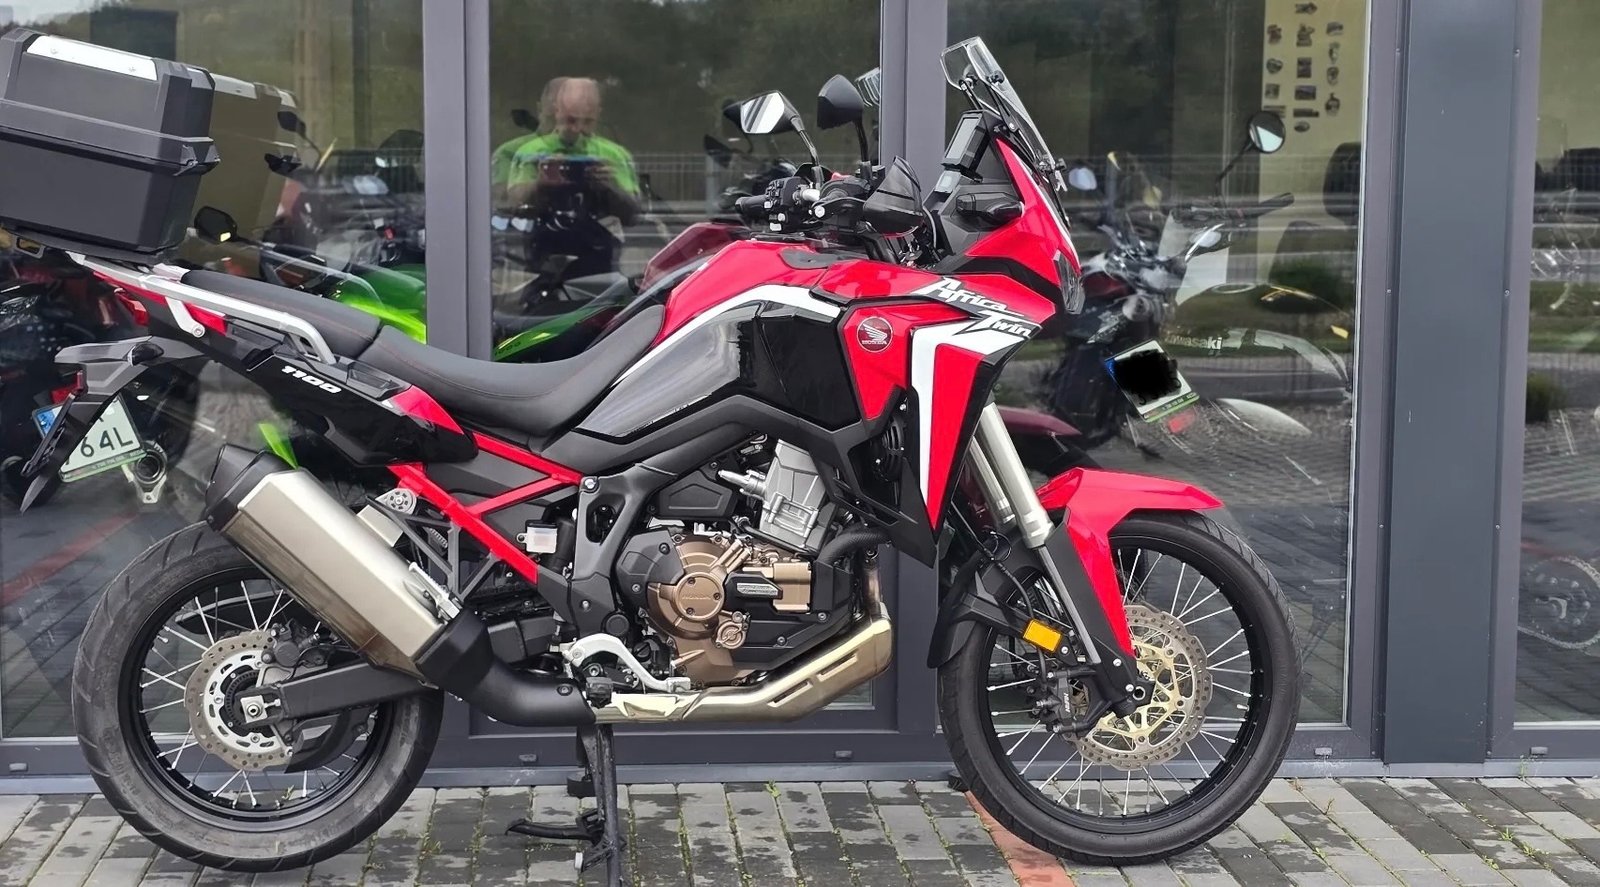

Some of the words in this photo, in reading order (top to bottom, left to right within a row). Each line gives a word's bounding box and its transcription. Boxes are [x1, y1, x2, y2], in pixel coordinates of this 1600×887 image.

[911, 276, 1016, 314] Africa
[958, 309, 1041, 338] Twin
[281, 365, 342, 393] 1100
